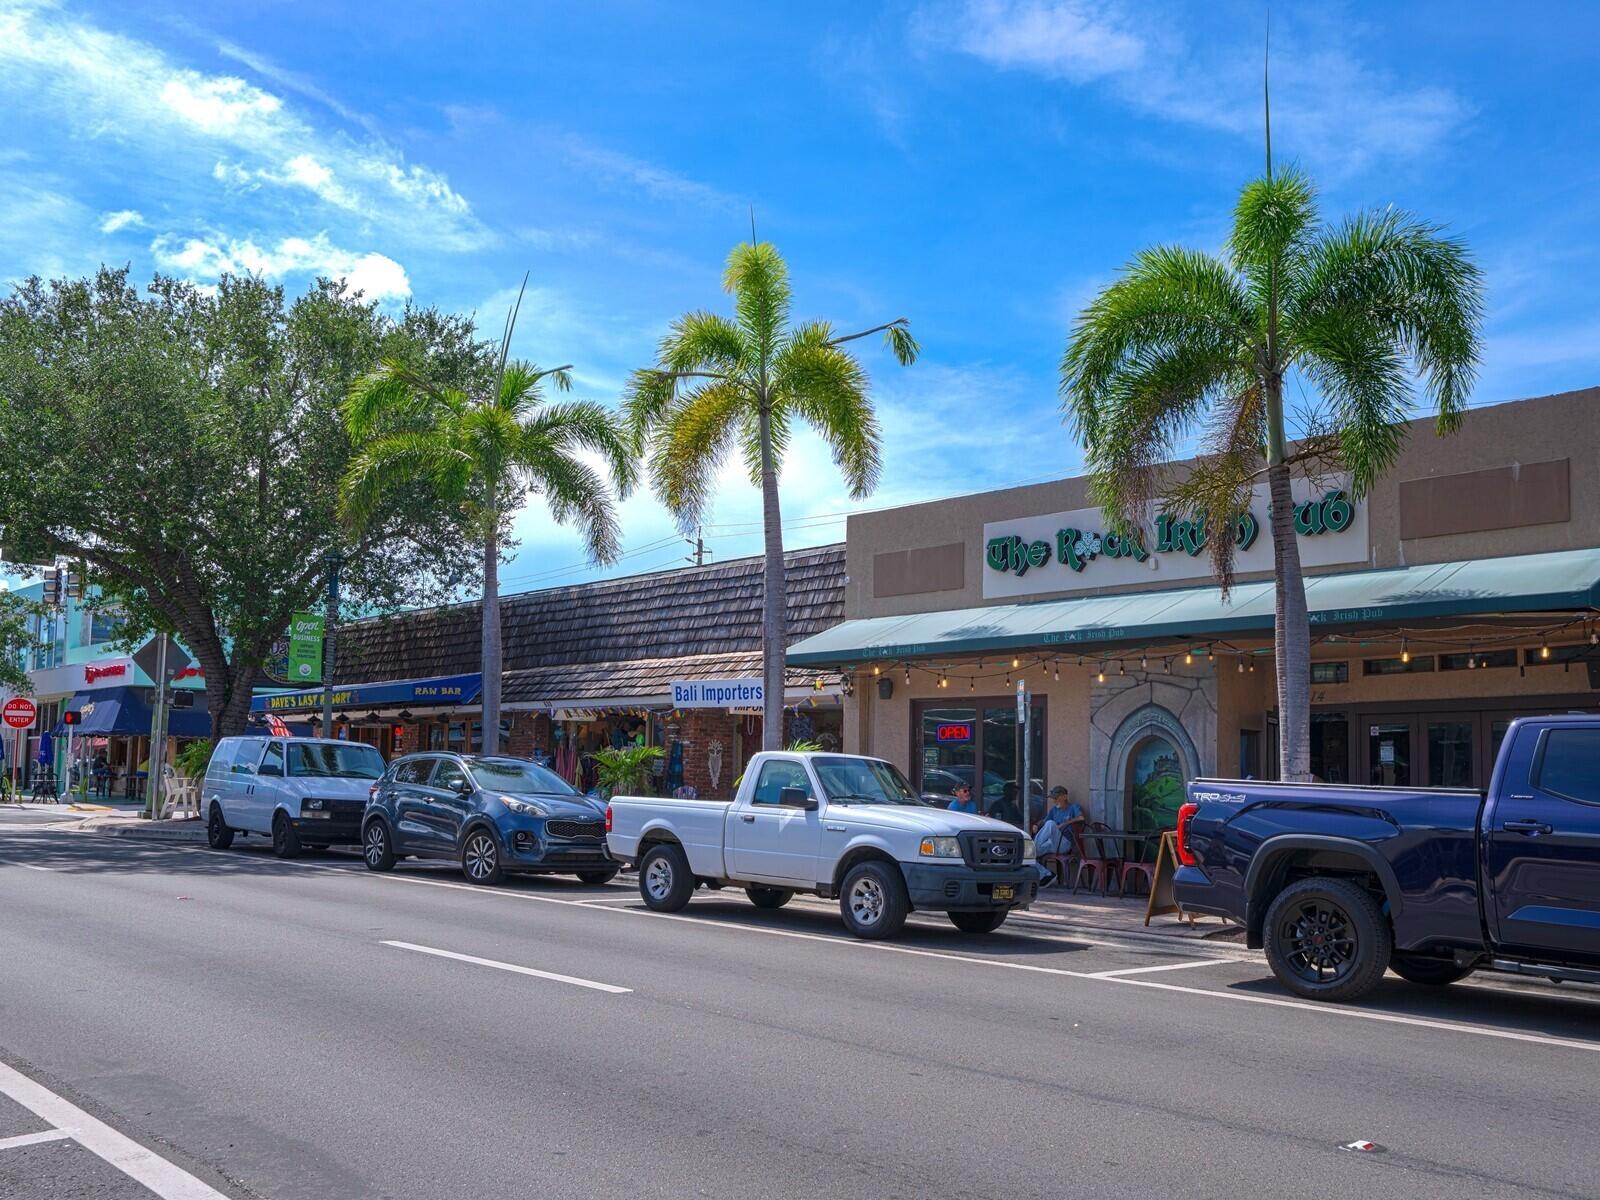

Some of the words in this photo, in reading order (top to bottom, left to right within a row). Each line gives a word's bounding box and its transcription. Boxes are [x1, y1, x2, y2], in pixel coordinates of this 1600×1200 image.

[986, 535, 1051, 577] The
[1154, 508, 1258, 557] Irih
[1267, 489, 1354, 536] ub
[296, 621, 319, 633] Open
[293, 634, 320, 642] BUSINESS
[414, 687, 437, 696] RAW
[441, 687, 462, 696] BAR
[675, 685, 697, 702] Bali
[702, 684, 763, 704] Importers
[271, 696, 297, 708] DAVE'S
[298, 694, 319, 706] LAST
[320, 691, 352, 704] RSORT
[940, 725, 968, 739] OPEN
[1193, 792, 1220, 802] TRD
